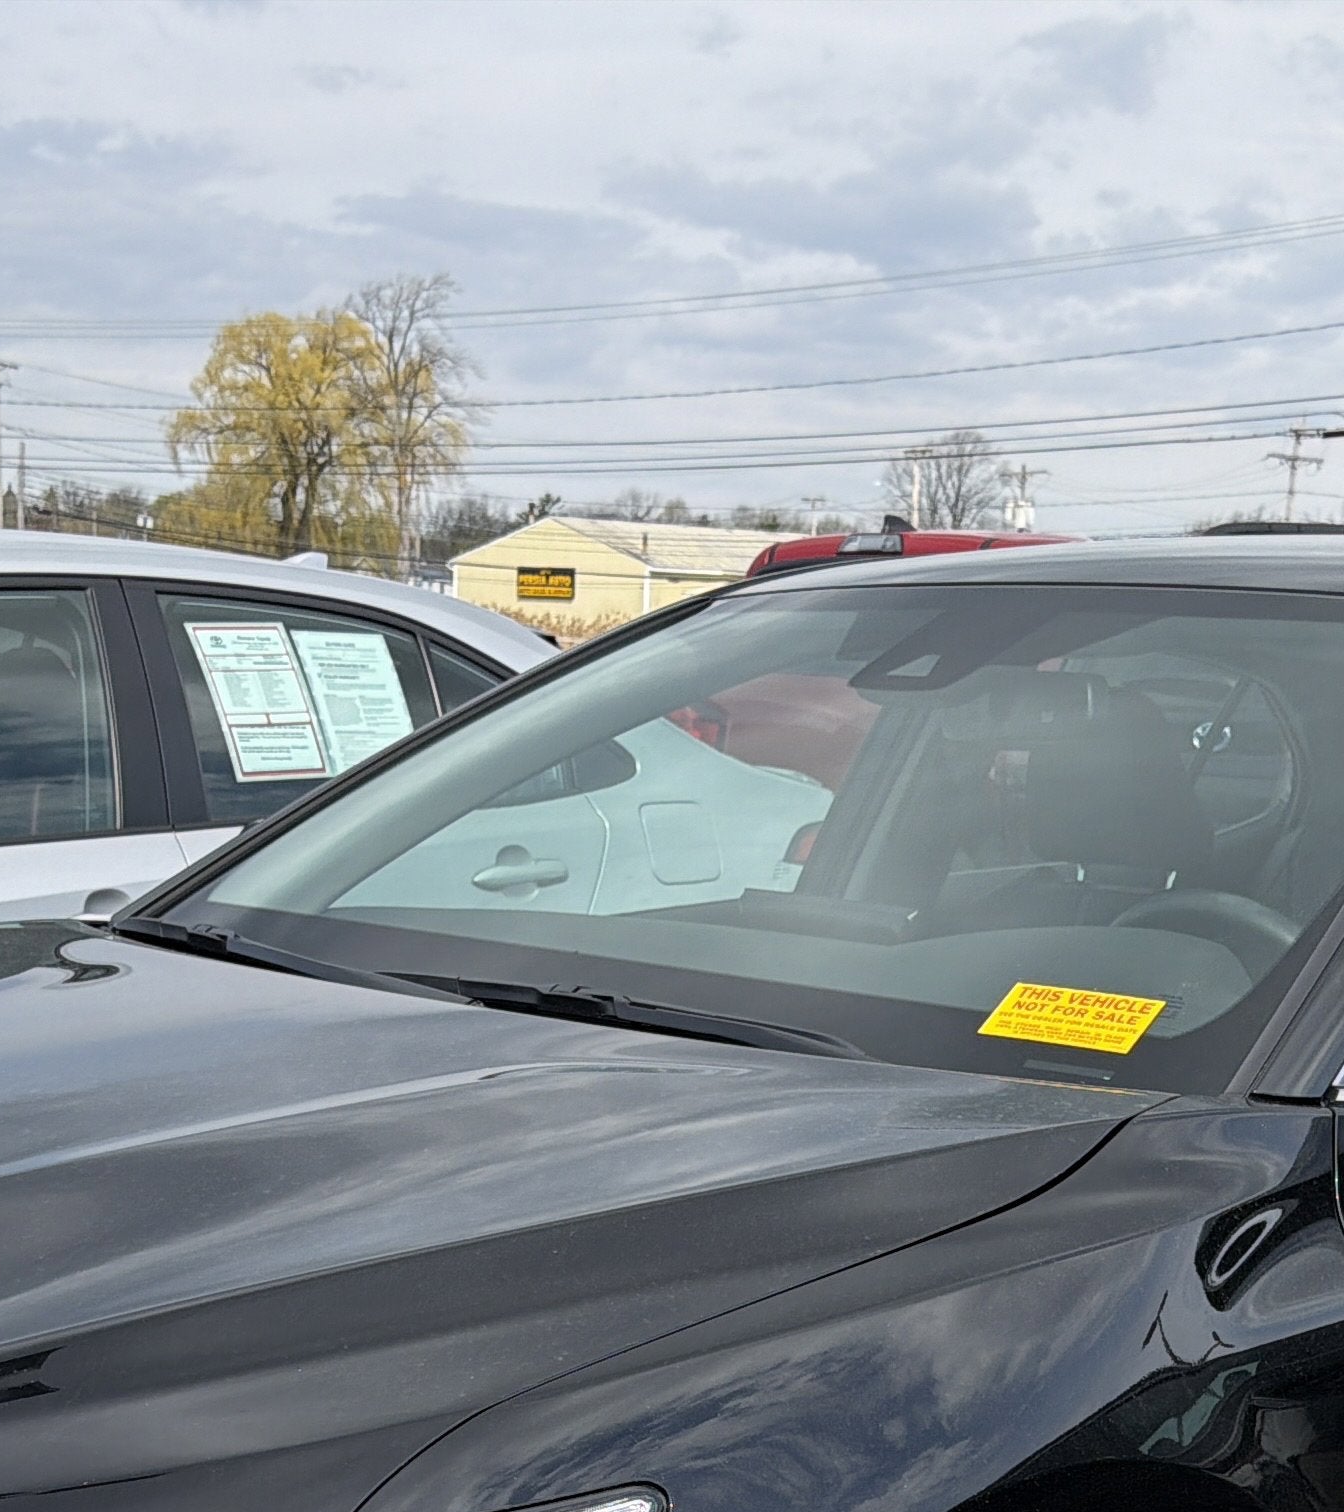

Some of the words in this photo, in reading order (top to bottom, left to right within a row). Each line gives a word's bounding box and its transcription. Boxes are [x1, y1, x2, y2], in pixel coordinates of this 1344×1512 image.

[1012, 1000, 1048, 1012] NOT
[1051, 1005, 1089, 1018] FOR
[1092, 1011, 1140, 1026] SALE
[1018, 986, 1062, 1003] THIS
[1068, 992, 1156, 1015] VEHICLE
